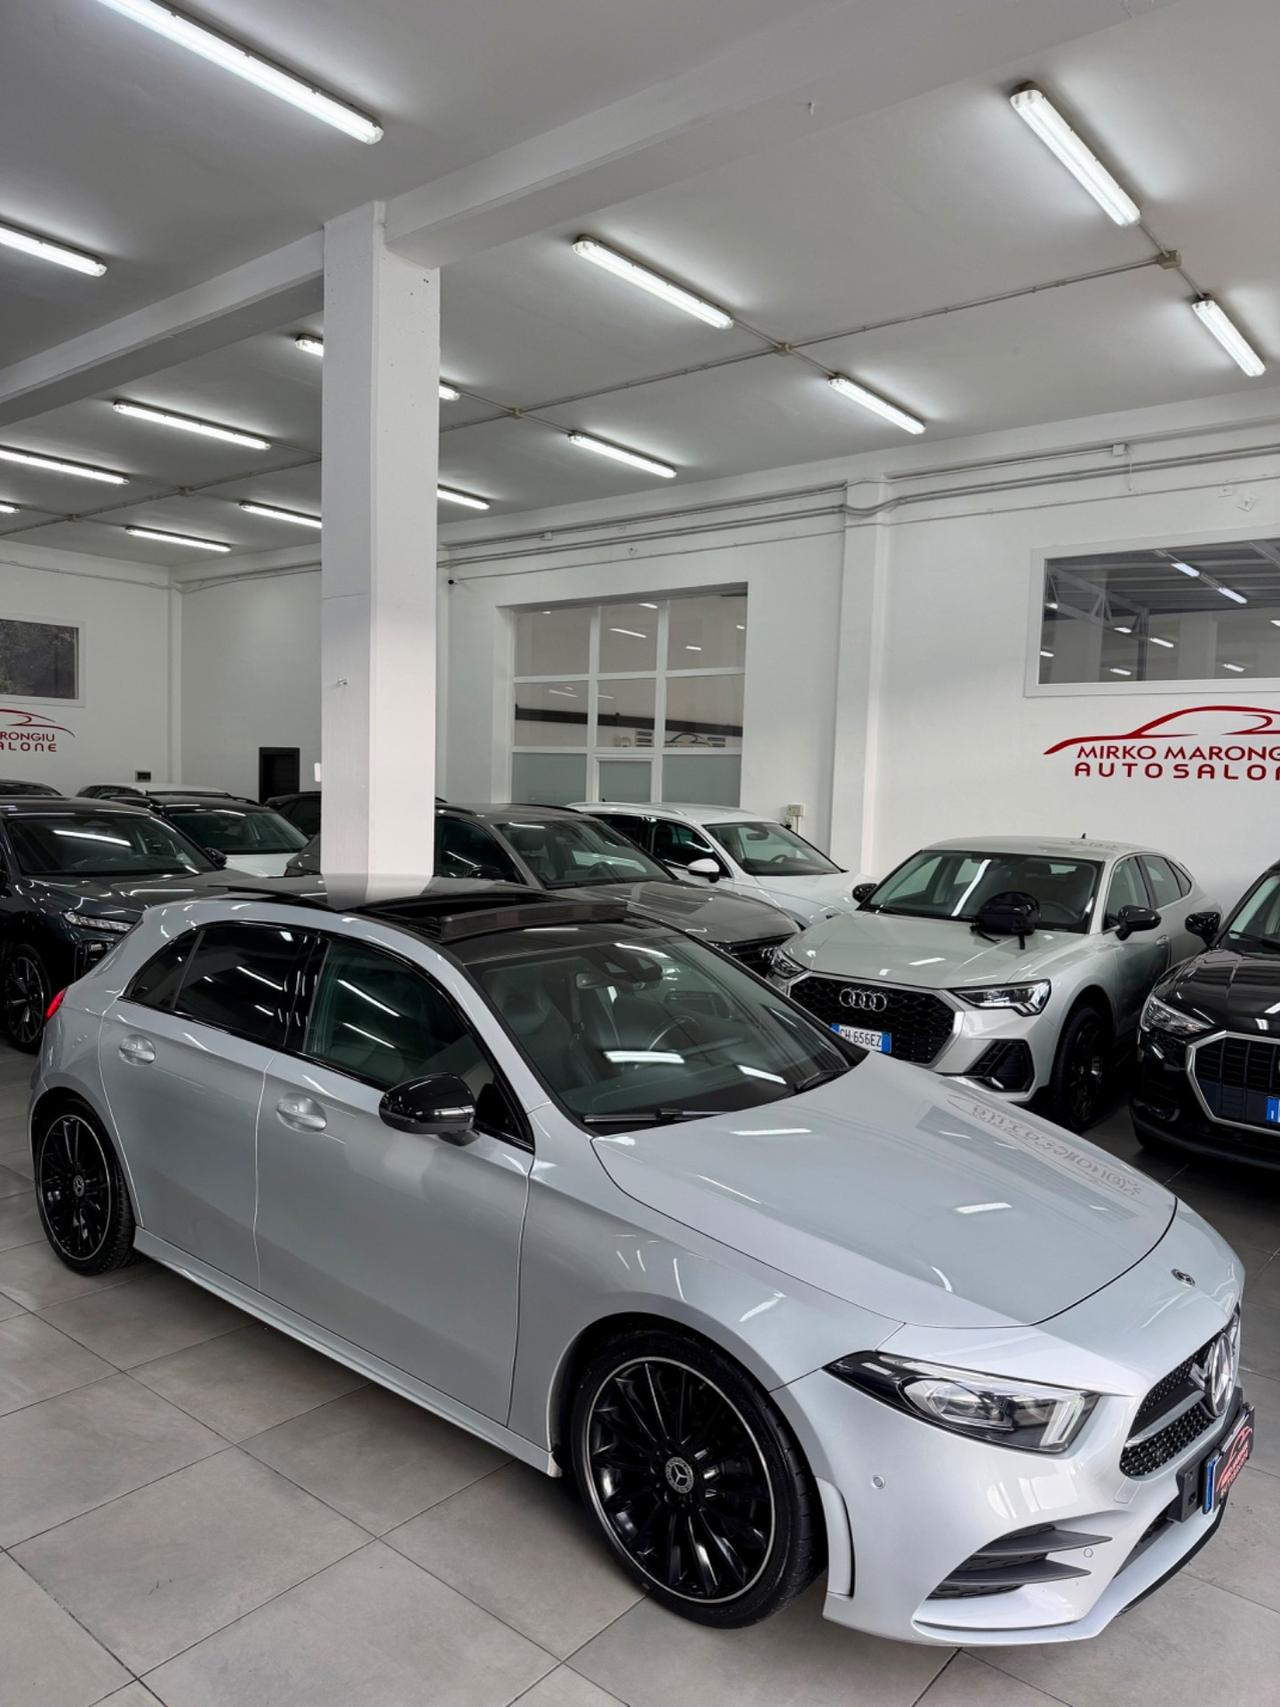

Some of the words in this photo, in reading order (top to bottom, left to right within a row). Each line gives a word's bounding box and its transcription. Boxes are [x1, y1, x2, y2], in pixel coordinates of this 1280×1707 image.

[0, 731, 55, 742] RONGIU
[1077, 745, 1156, 760] MIRKO
[1074, 762, 1280, 781] AUTOSALO
